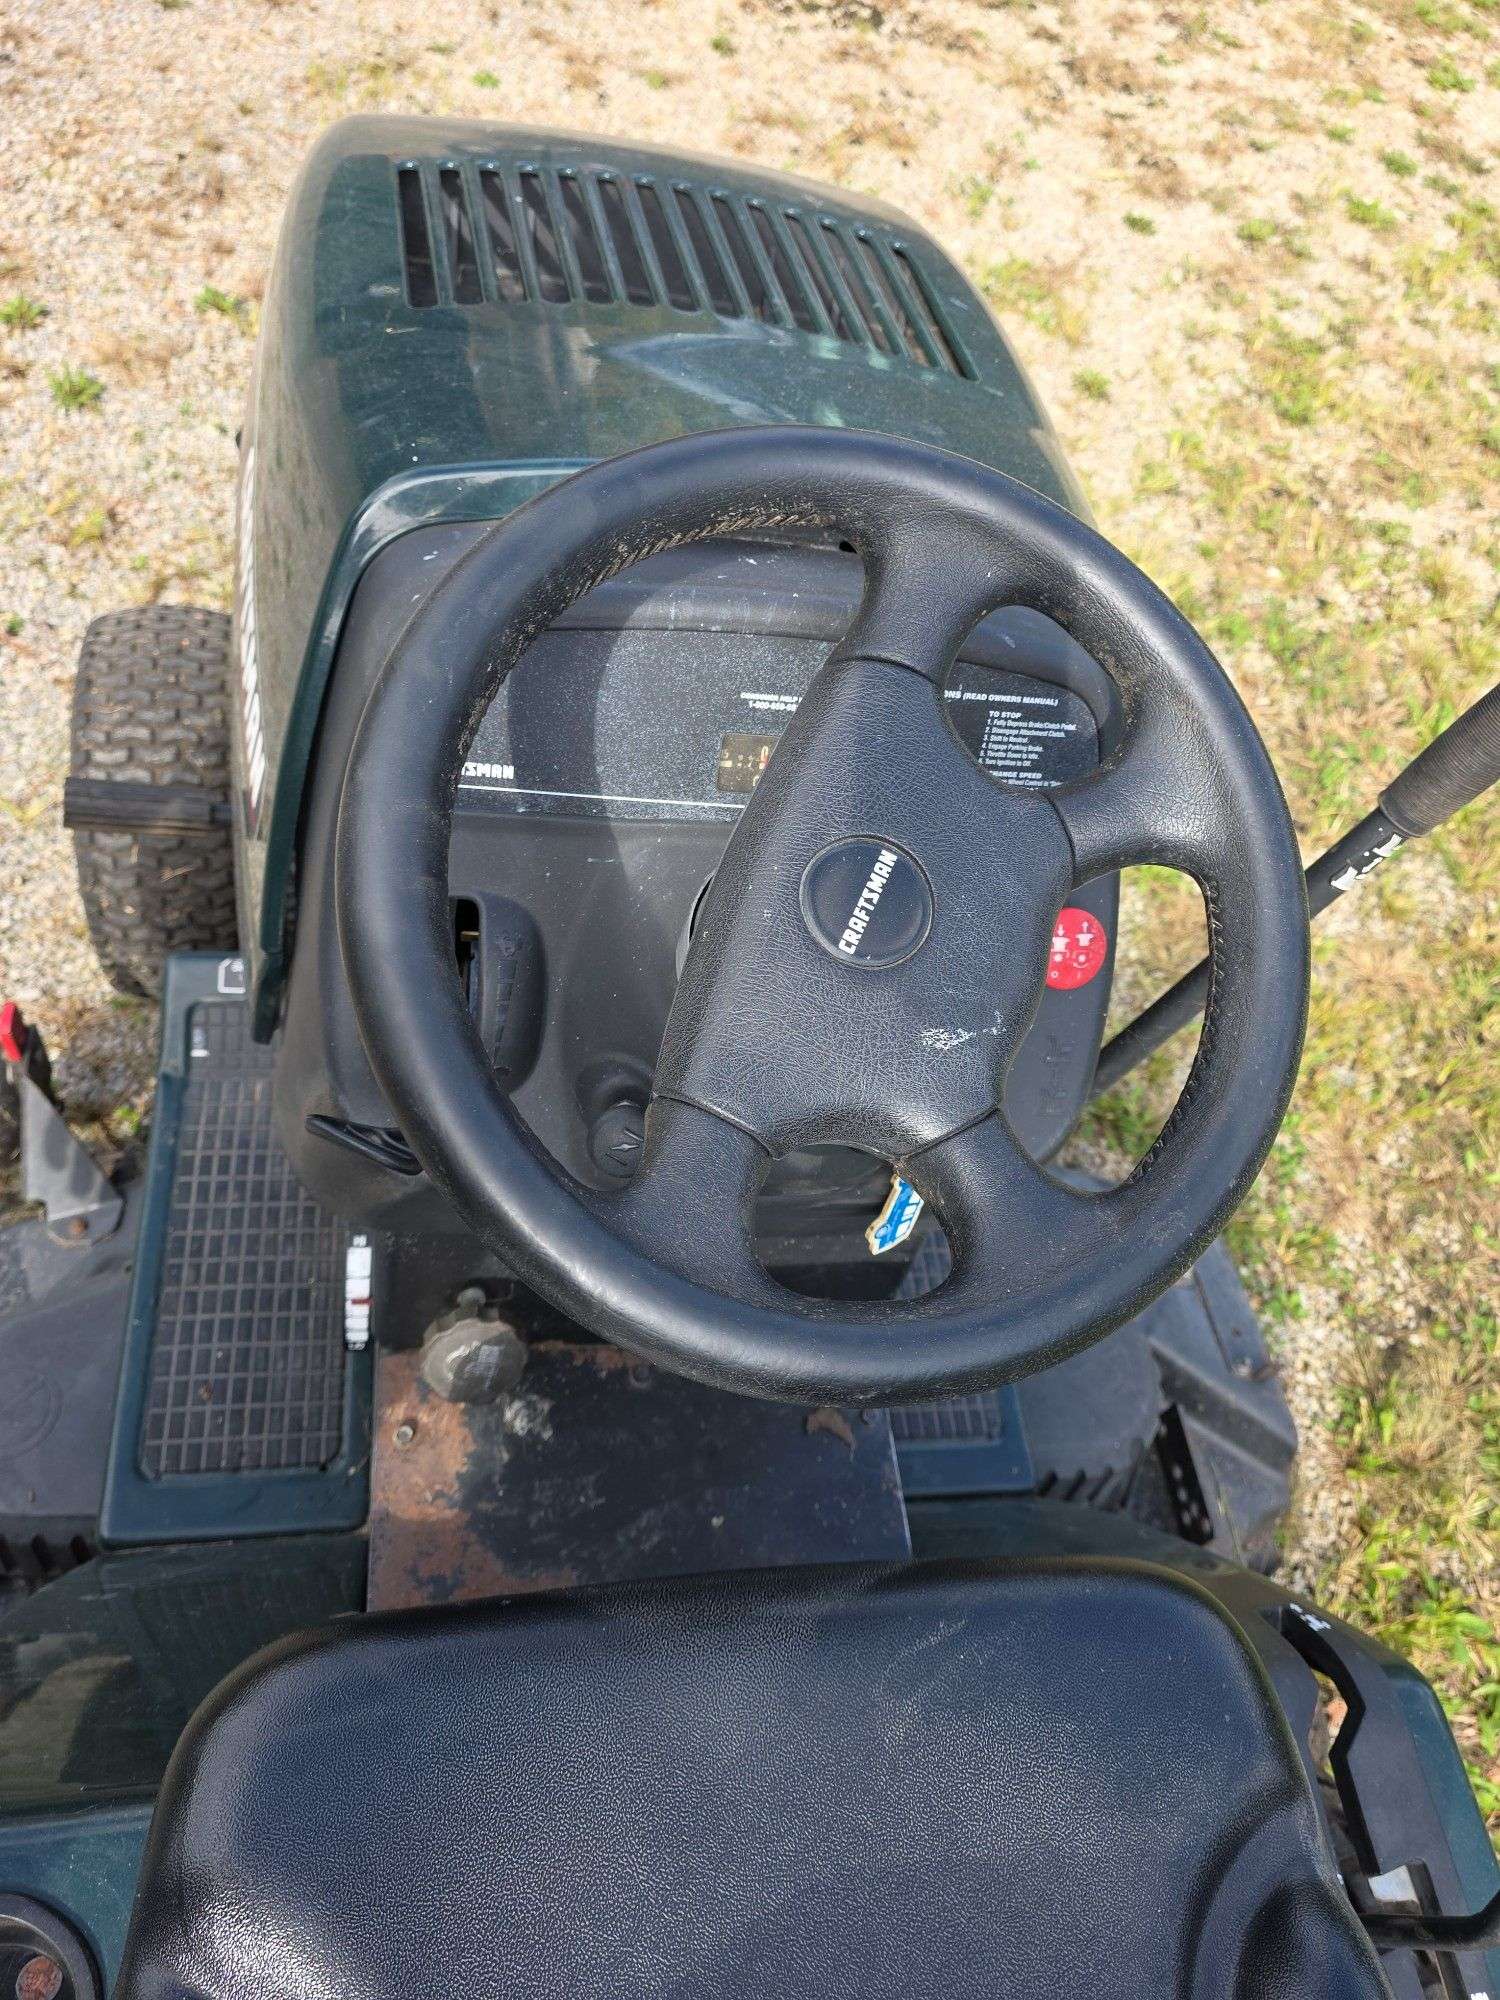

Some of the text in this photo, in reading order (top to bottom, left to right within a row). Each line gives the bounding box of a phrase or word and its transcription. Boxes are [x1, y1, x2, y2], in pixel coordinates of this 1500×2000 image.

[963, 692, 987, 701] (READ
[988, 694, 1021, 703] OWNERS
[1022, 696, 1058, 706] MANUAL)
[1001, 711, 1022, 719] STOP
[838, 849, 898, 955] CRAFTSMAN
